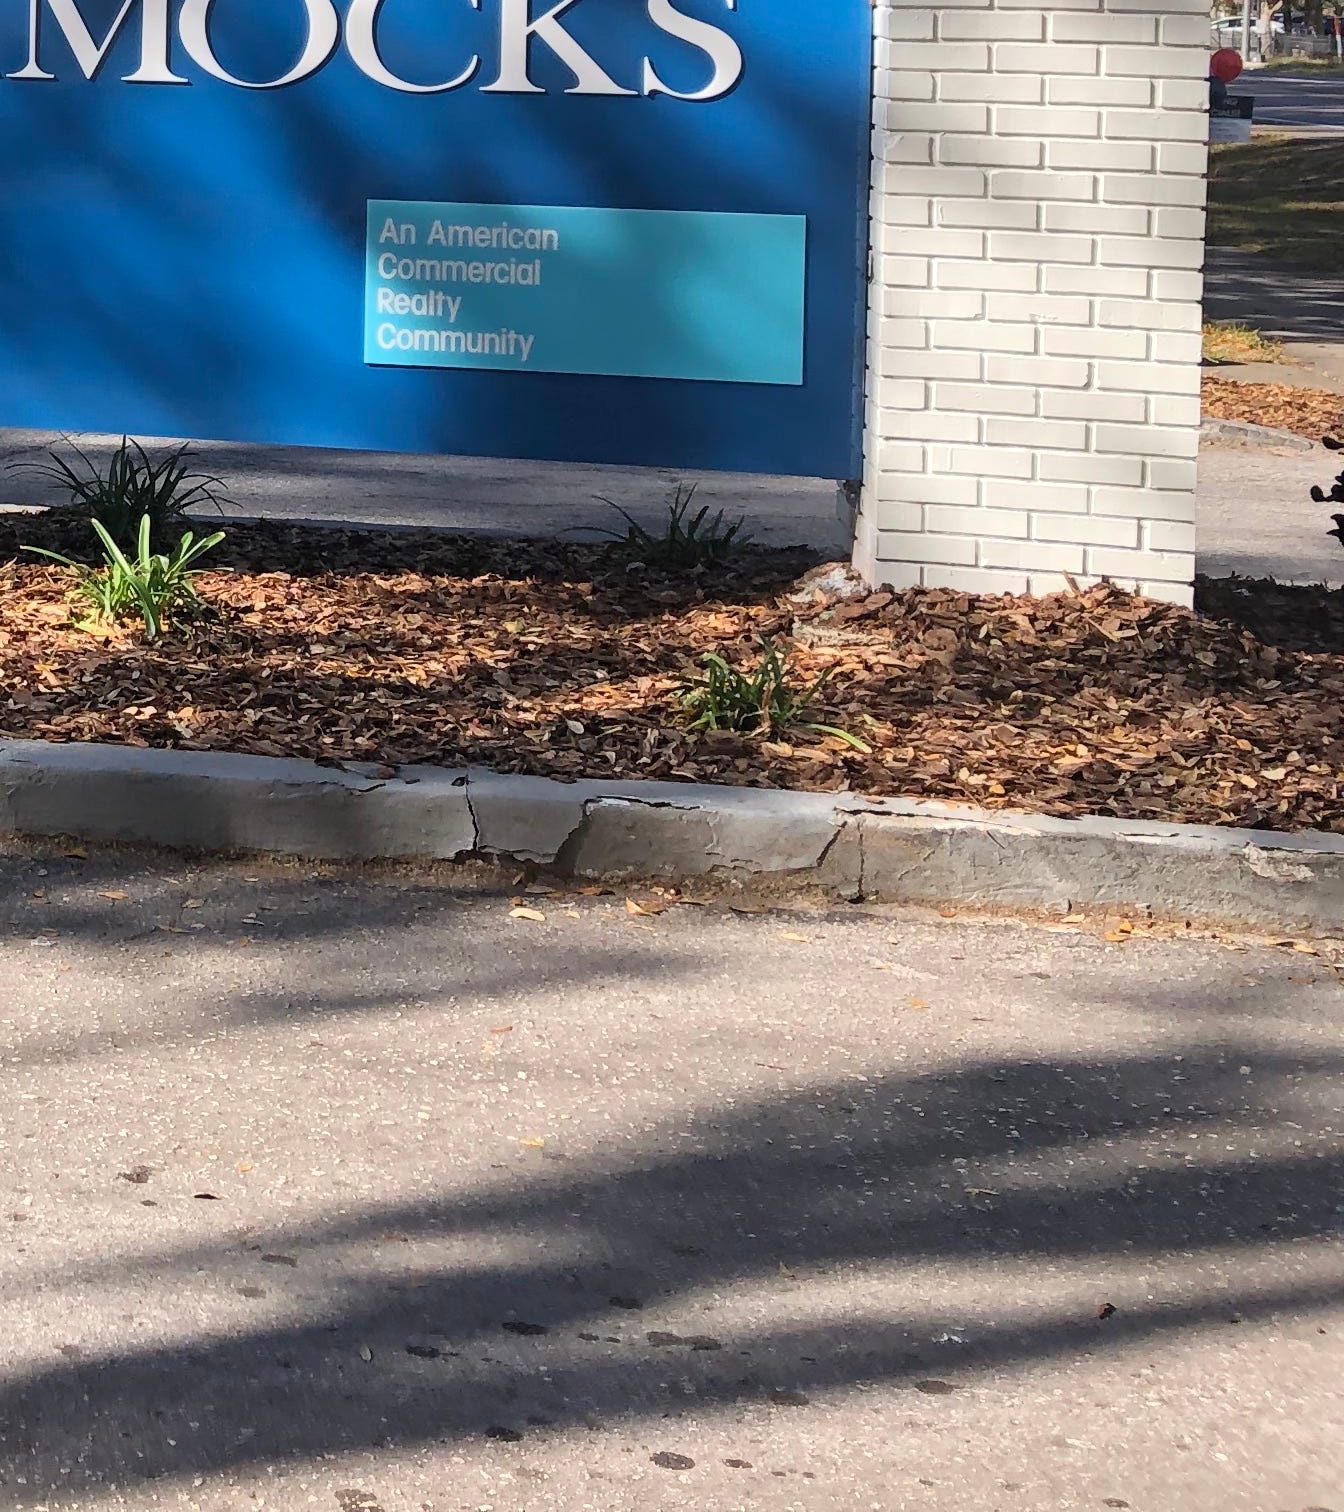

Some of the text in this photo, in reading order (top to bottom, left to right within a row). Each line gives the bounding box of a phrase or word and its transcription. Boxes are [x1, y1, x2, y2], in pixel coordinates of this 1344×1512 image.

[378, 217, 560, 252] An American
[377, 252, 542, 287] Commercial
[377, 287, 463, 323] Realty
[377, 321, 535, 362] Community
